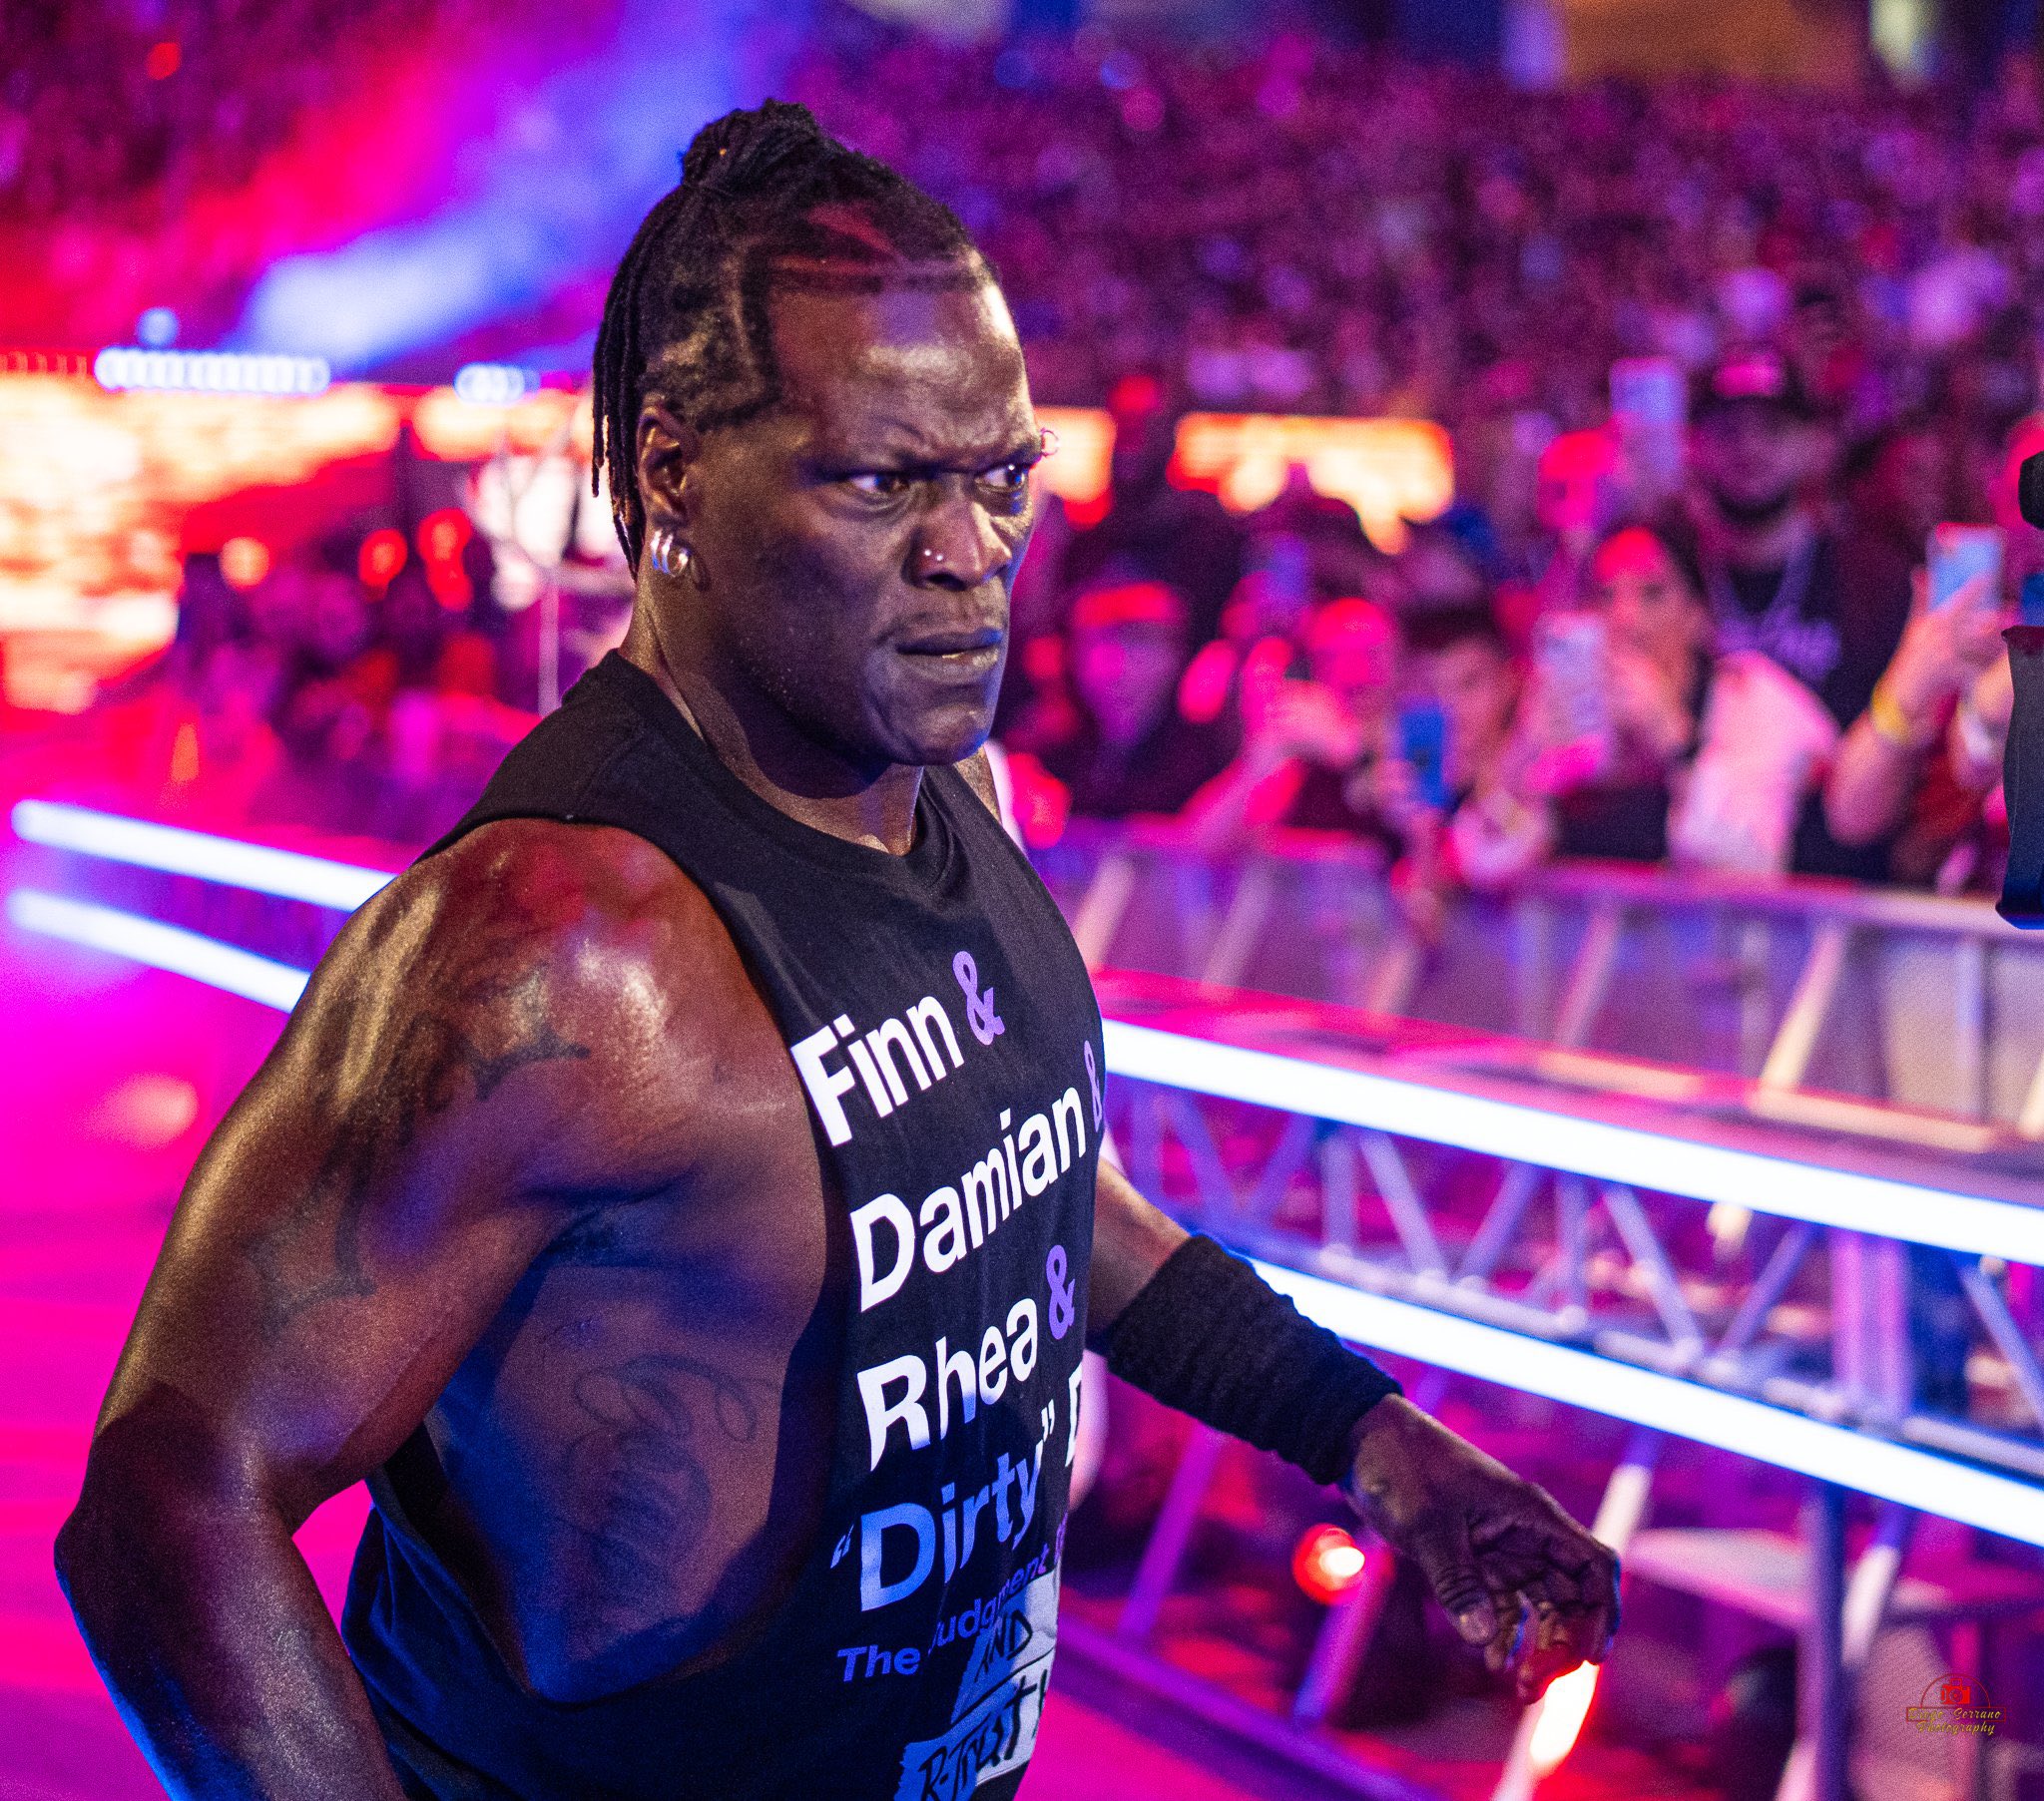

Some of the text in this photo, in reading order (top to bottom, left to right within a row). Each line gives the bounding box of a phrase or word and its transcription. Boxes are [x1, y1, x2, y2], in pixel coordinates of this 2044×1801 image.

[790, 951, 1005, 1146] Finn &
[850, 1088, 1086, 1312] Damian
[857, 1298, 1038, 1472] Rhea
[1046, 1244, 1075, 1339] &
[837, 1645, 920, 1682] The
